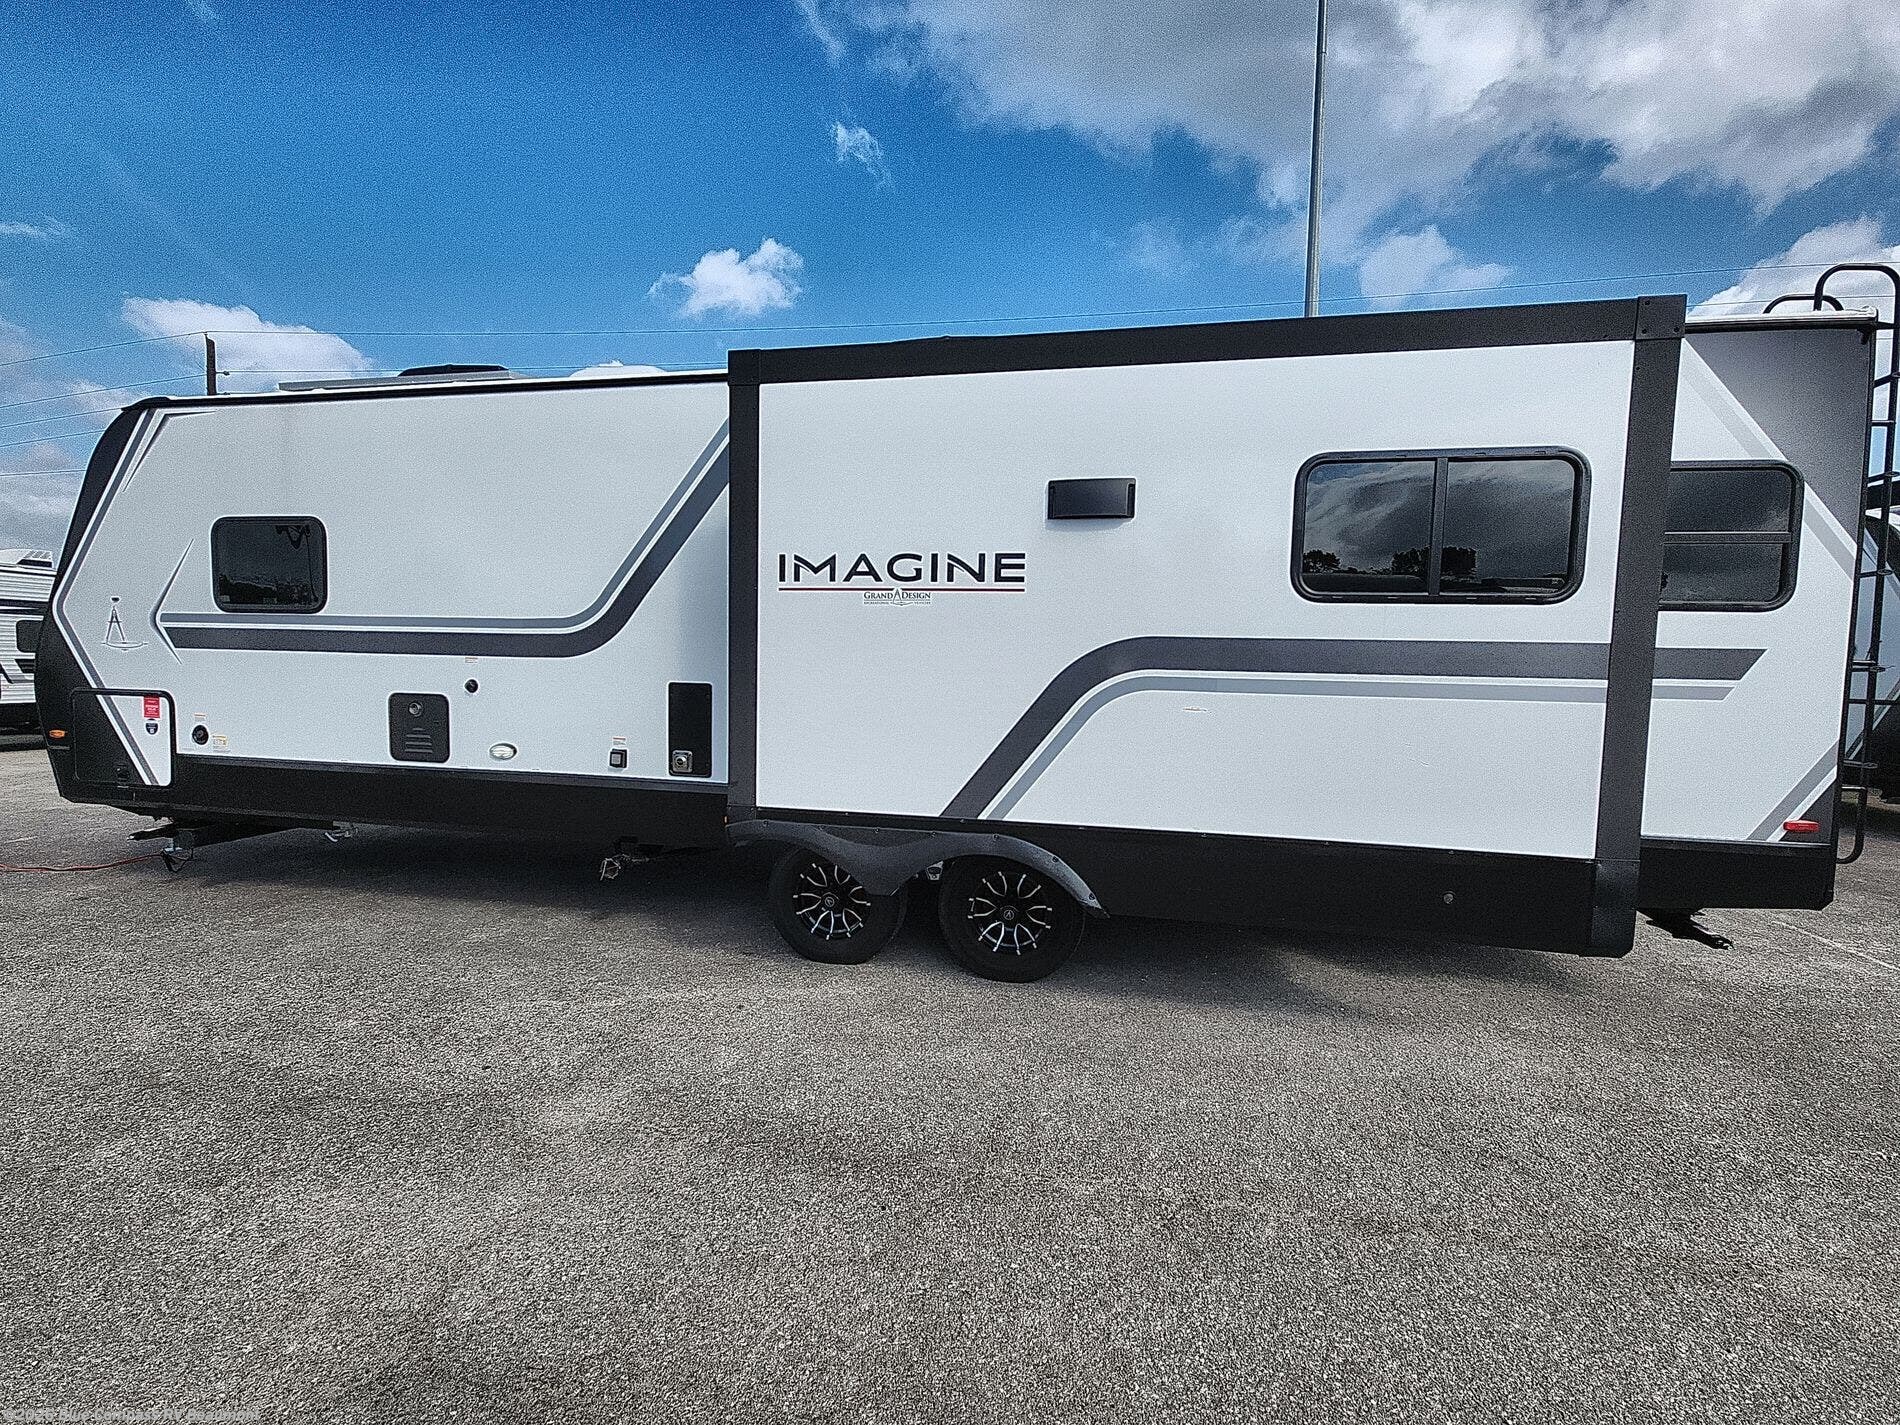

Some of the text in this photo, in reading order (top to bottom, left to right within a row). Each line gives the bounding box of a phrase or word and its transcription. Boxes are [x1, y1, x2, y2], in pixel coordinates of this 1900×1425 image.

[778, 552, 1026, 583] IMAGINE
[863, 591, 931, 599] GRAND DESIGN
